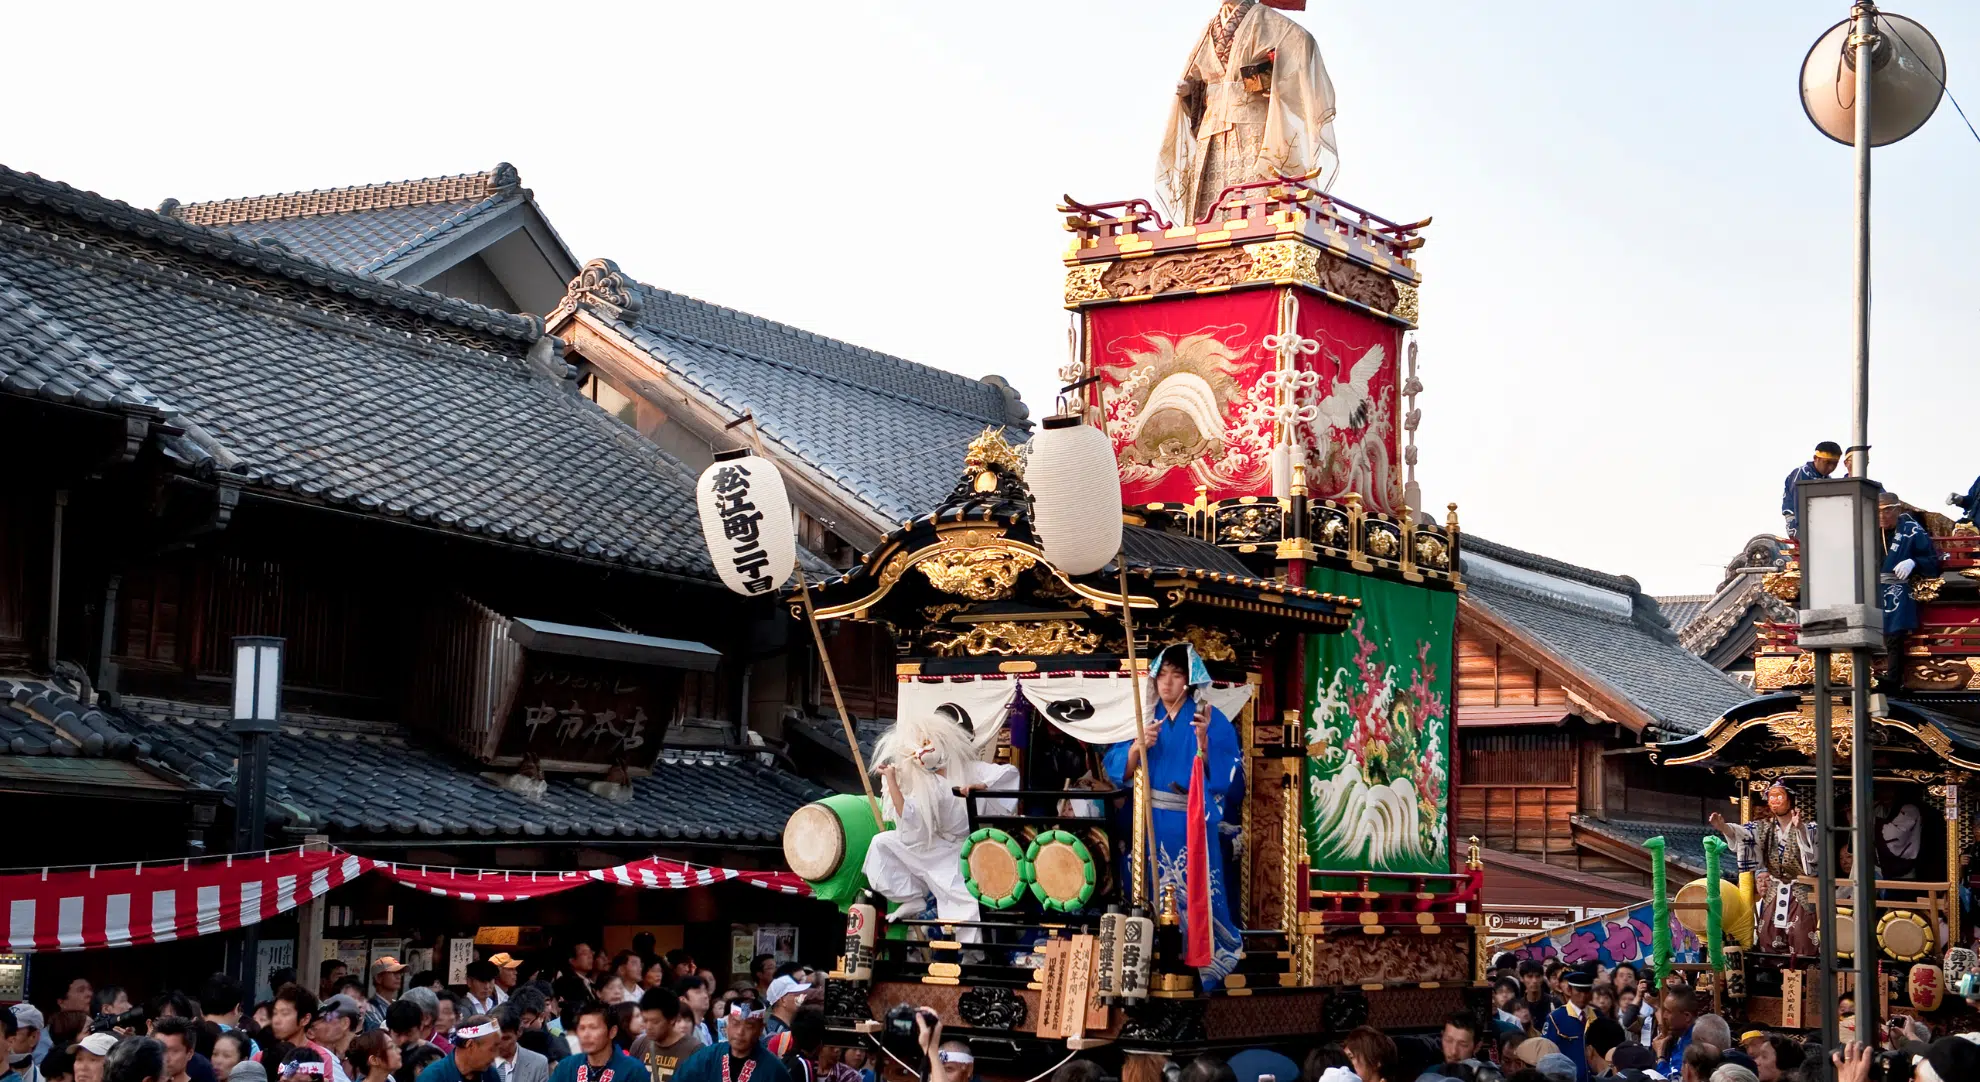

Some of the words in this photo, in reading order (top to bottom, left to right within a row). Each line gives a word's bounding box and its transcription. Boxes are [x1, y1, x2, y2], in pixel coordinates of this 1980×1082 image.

[710, 464, 774, 594] 松江町二丁目
[523, 699, 649, 755] 中市本店
[1068, 949, 1082, 996] 文久年間
